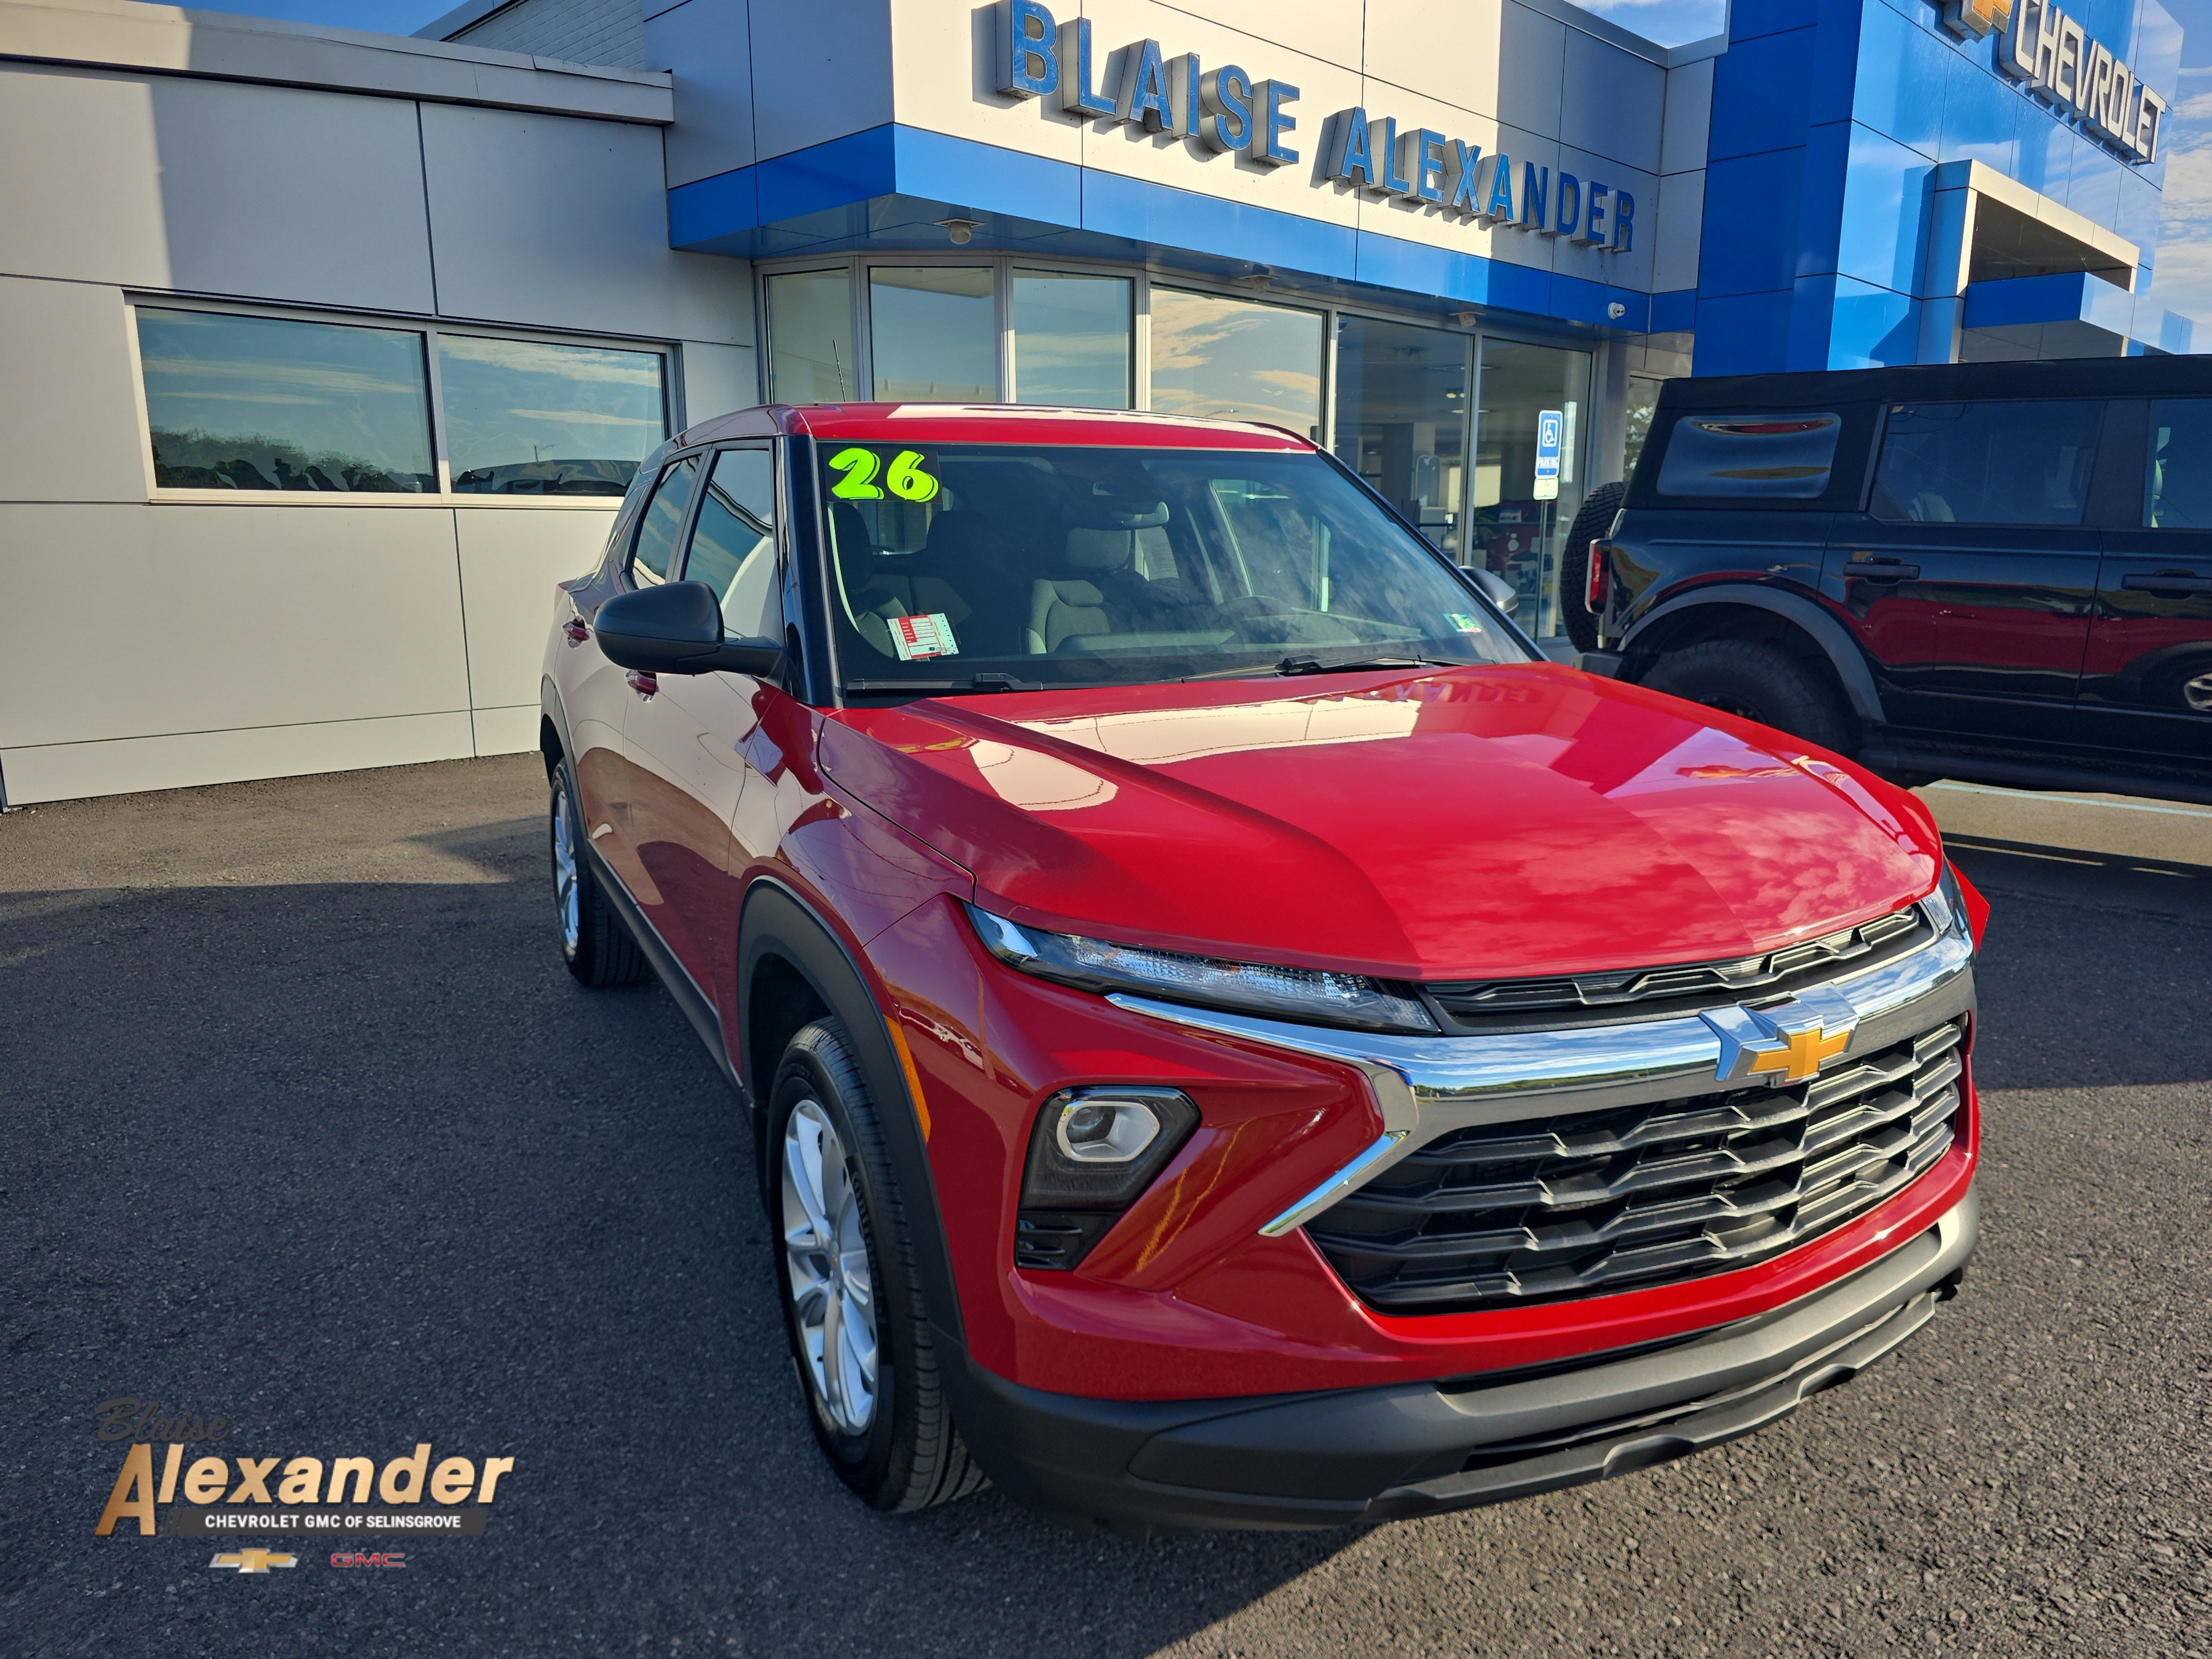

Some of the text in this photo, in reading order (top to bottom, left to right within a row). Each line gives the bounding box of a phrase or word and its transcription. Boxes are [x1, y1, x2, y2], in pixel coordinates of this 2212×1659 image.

[1009, 0, 1636, 253] BLAISE ALEXANDER
[2016, 0, 2167, 164] CHEVROLET
[828, 448, 939, 503] 26
